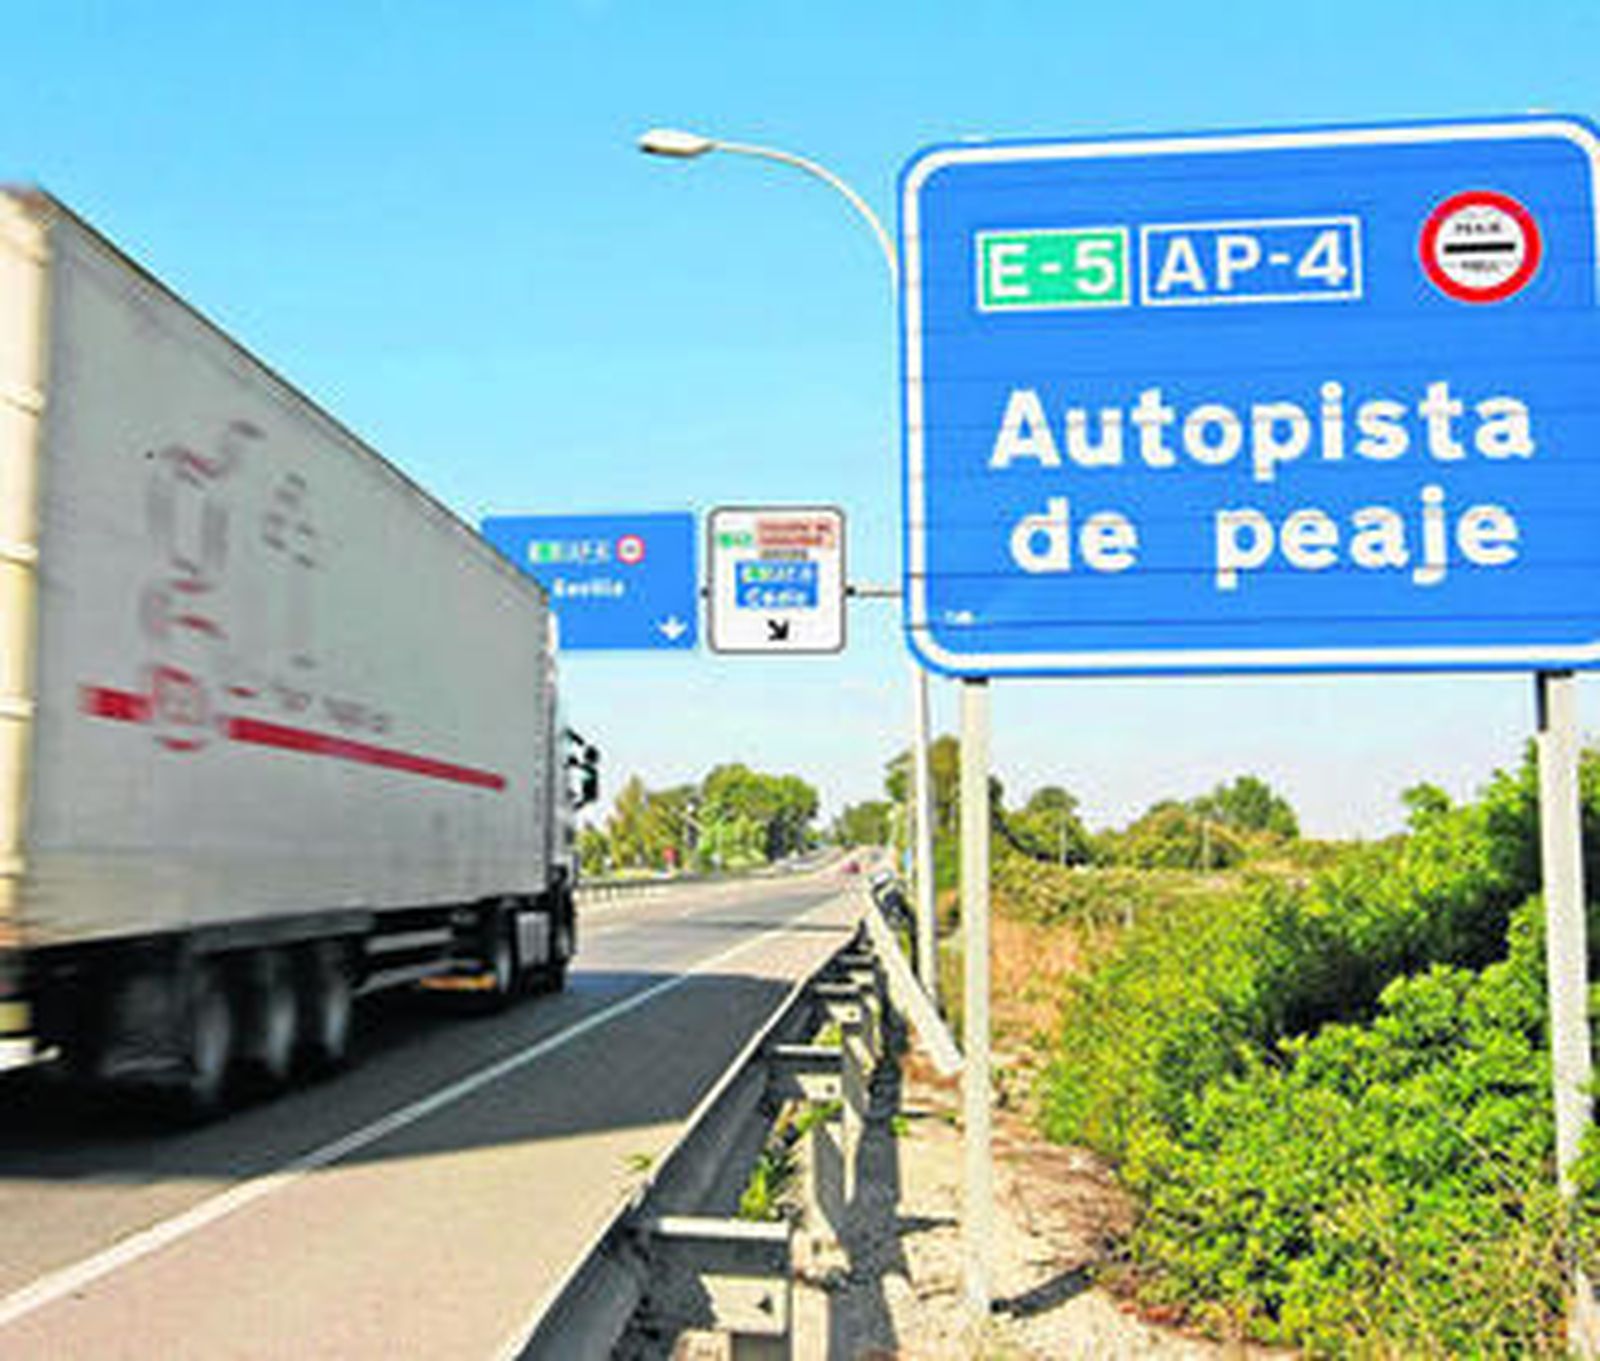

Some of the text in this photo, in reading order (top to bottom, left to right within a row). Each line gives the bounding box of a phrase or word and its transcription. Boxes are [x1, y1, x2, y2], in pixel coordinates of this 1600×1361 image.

[988, 230, 1349, 298] E-5 AP-4
[988, 381, 1535, 482] Autopista
[1009, 497, 1139, 573] de
[1215, 485, 1520, 590] peaje
